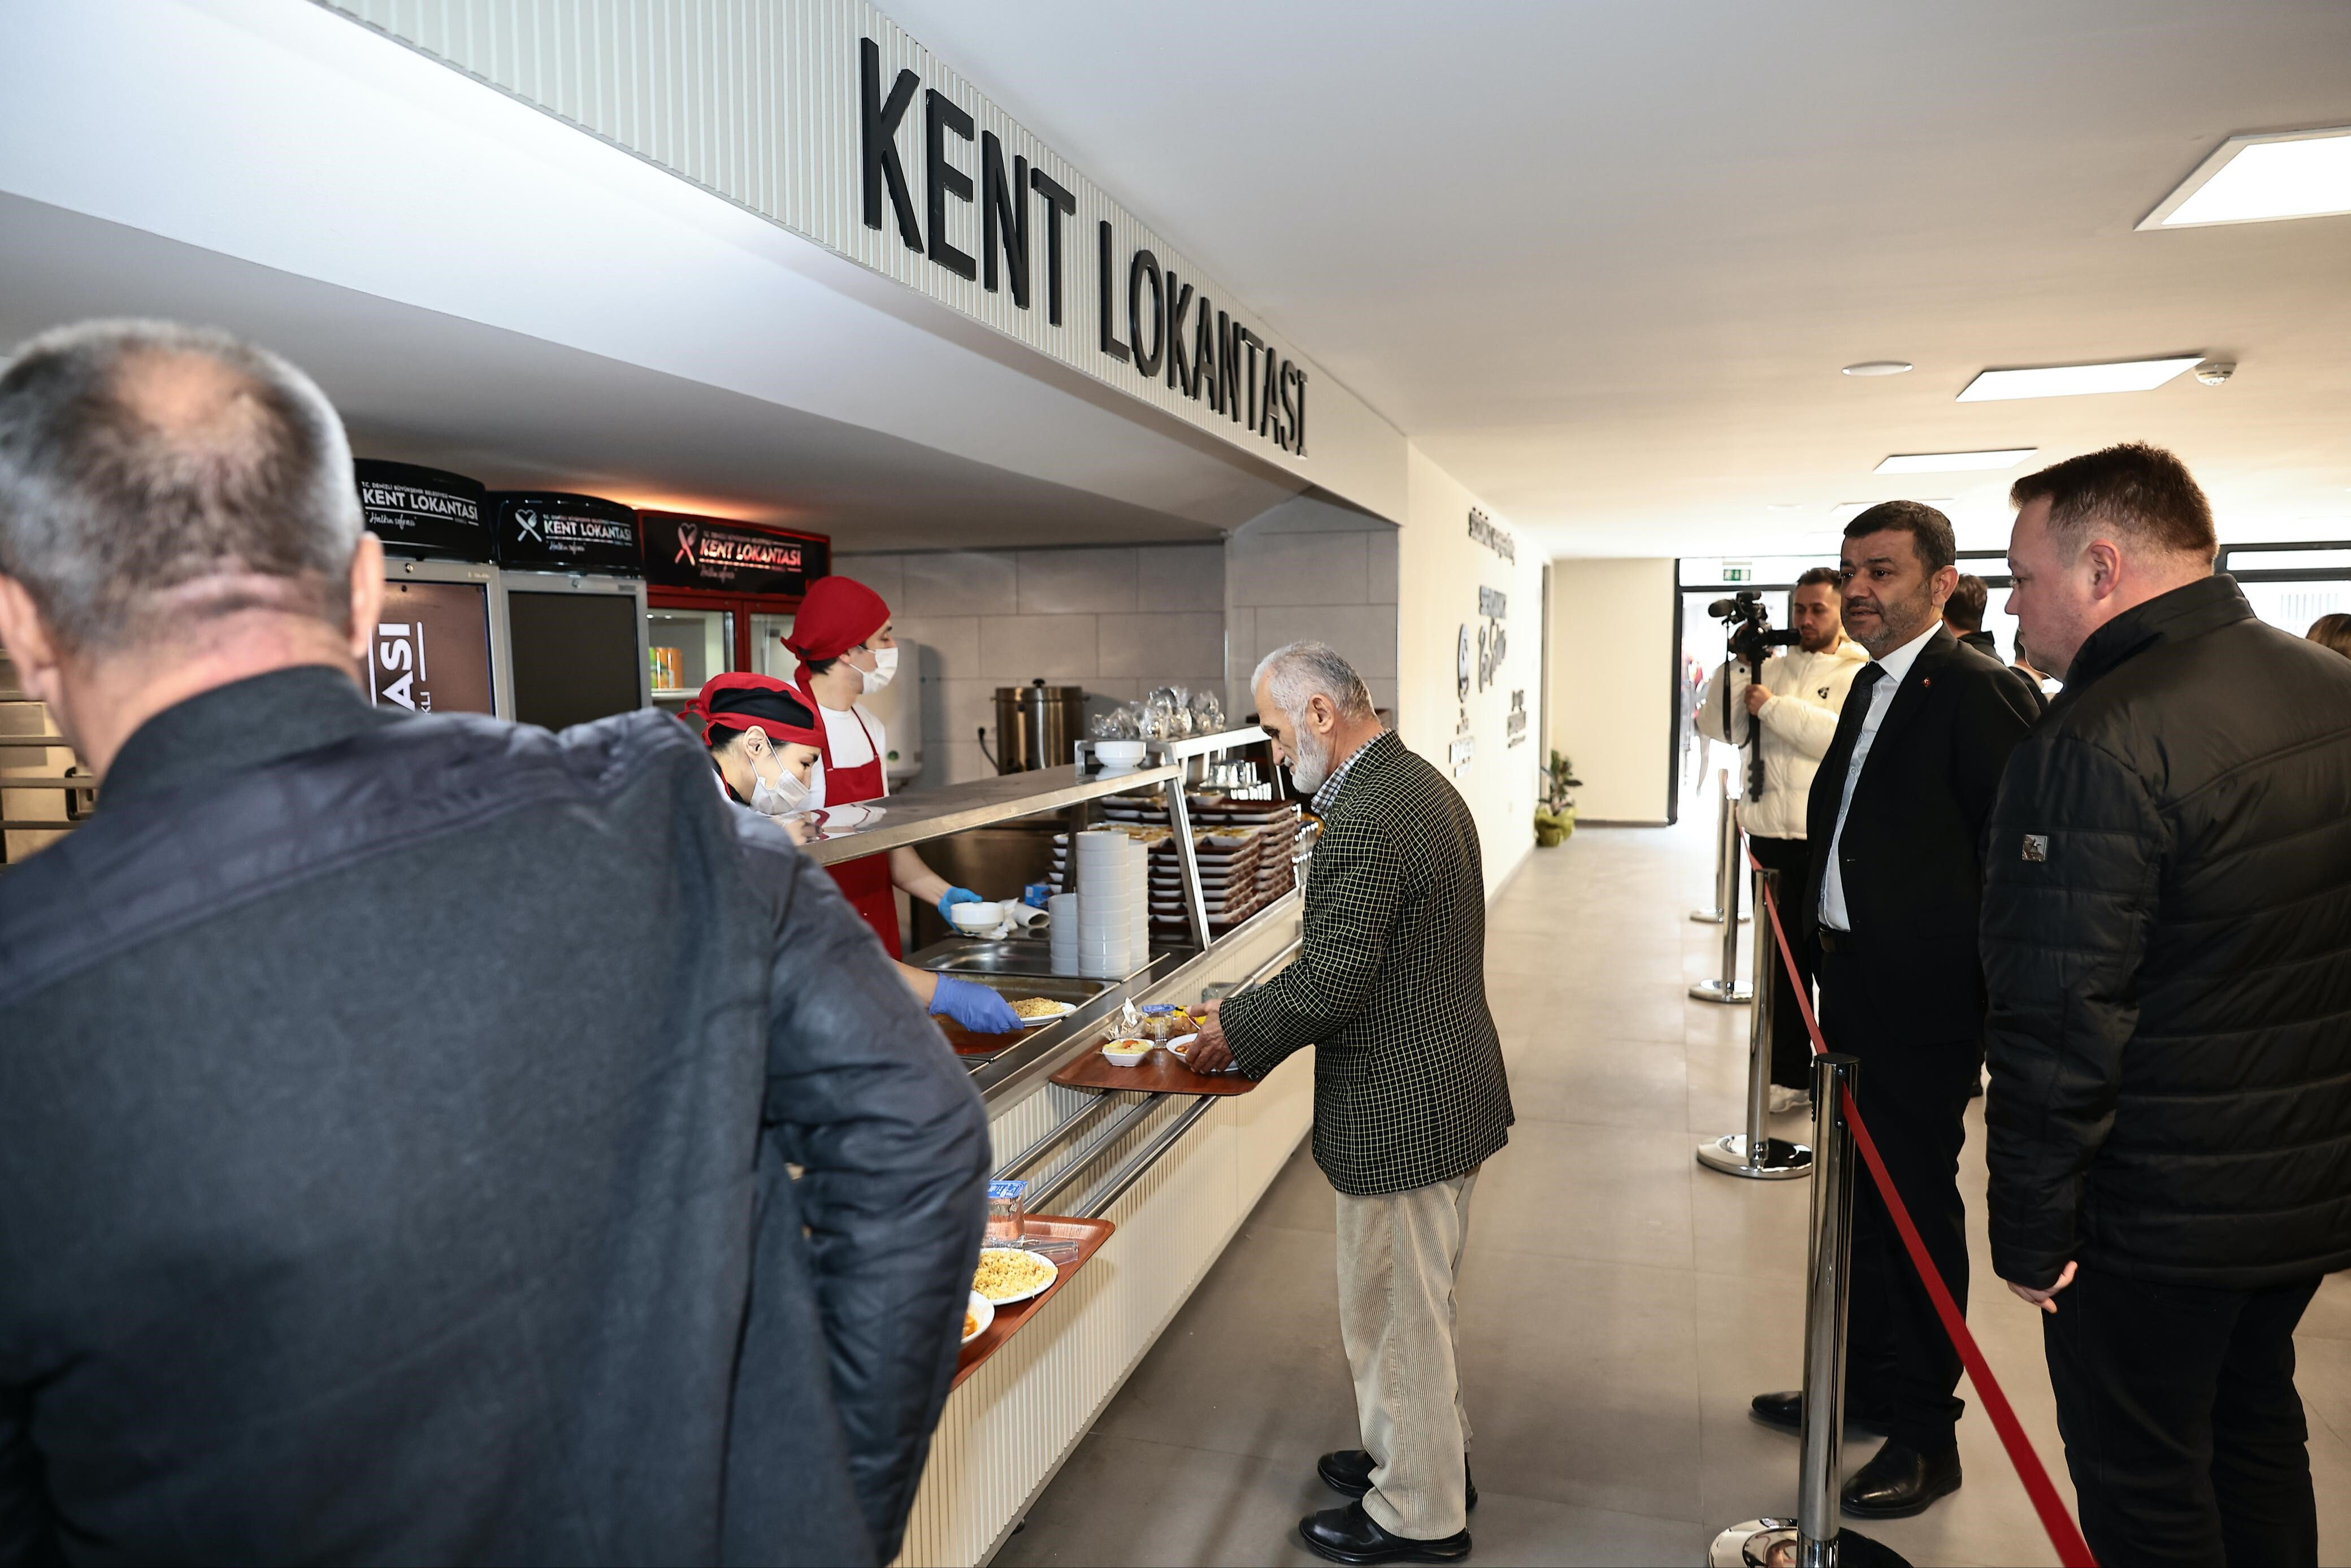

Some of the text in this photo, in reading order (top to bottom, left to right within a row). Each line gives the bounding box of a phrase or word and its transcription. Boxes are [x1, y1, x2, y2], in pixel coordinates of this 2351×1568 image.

[861, 37, 1308, 458] KENT LOKANTASI
[363, 488, 478, 520] KENT LOKANTASI
[543, 520, 632, 541] KENT LOKANTASI
[699, 538, 735, 559] KENT
[736, 543, 801, 566] LOKANTASI
[379, 623, 415, 711] ASI
